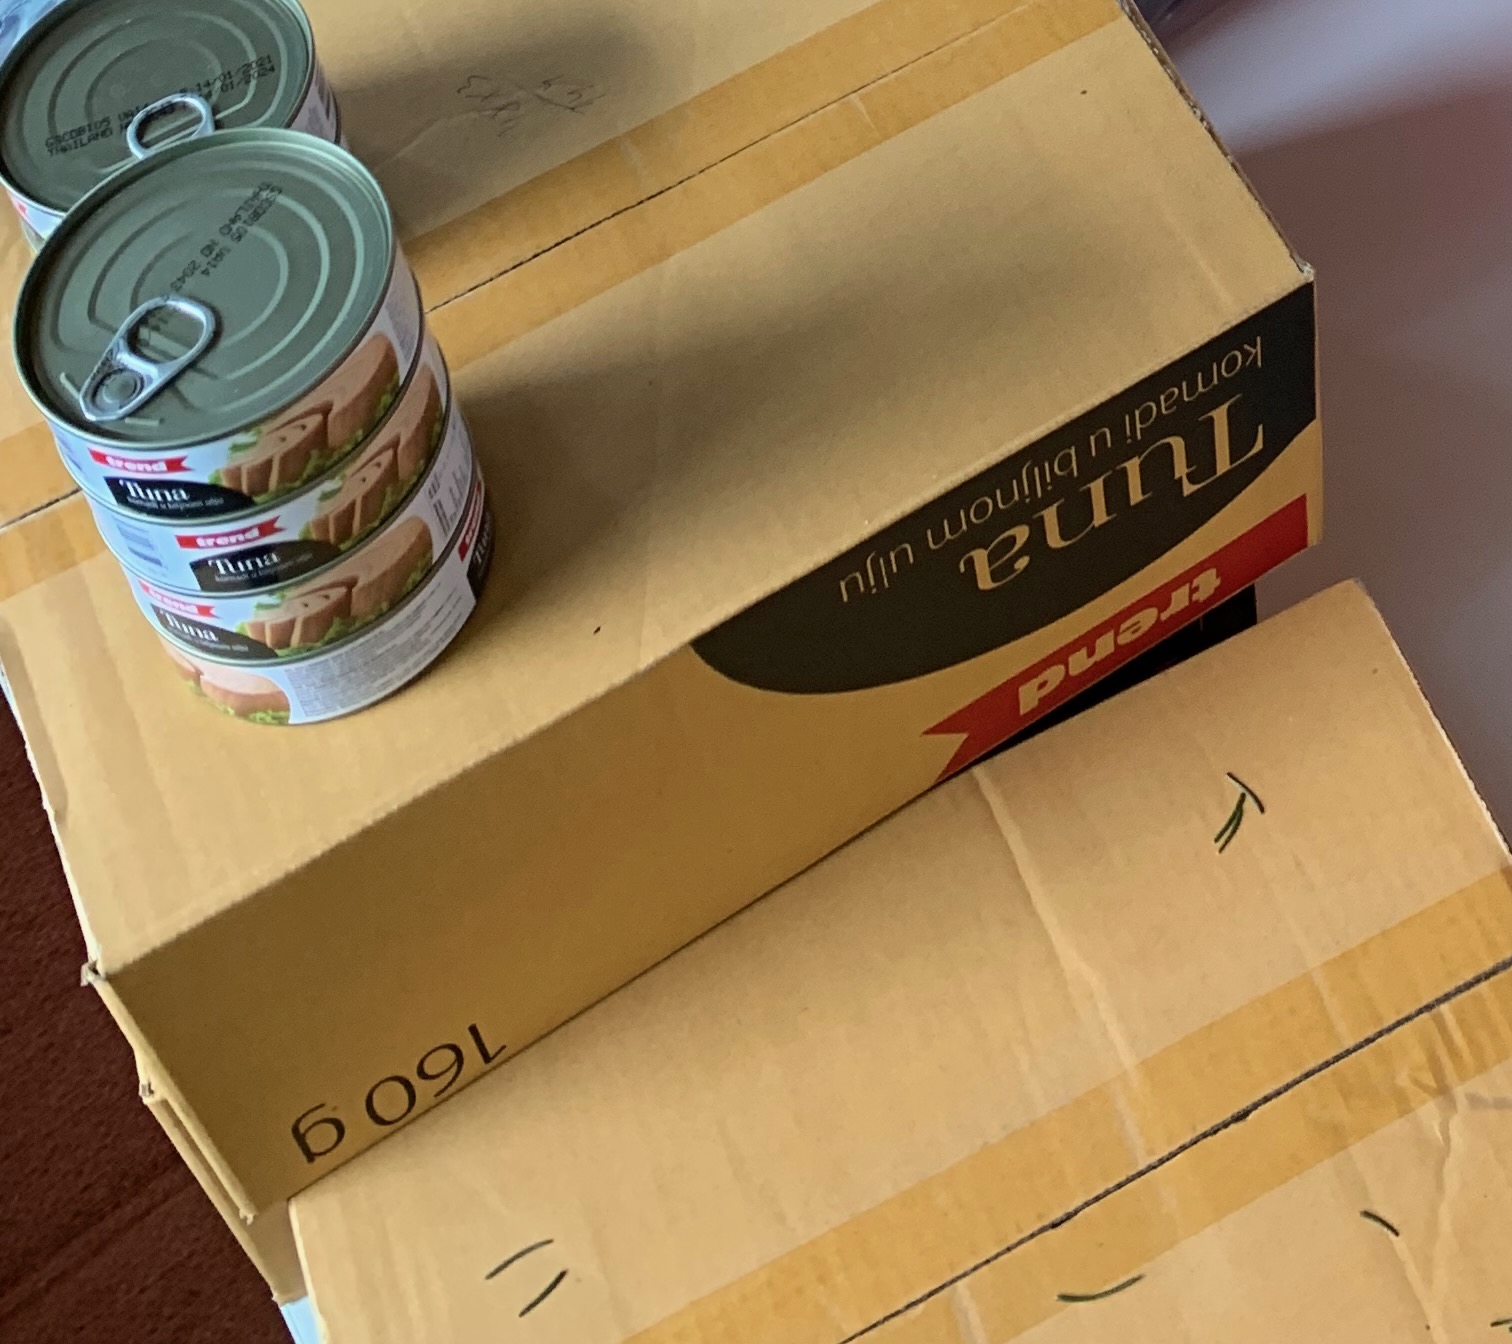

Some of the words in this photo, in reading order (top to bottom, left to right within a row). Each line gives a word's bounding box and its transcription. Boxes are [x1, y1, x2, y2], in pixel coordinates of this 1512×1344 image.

[1125, 335, 1264, 444] komadi
[106, 455, 167, 472] trend
[1091, 426, 1114, 445] u
[119, 479, 190, 502] Tuna
[928, 443, 1078, 550] biljnom
[959, 395, 1264, 590] Tuna
[196, 529, 258, 547] trend
[208, 552, 281, 576] Tuna
[839, 542, 914, 603] ulju
[160, 609, 219, 642] Tuna
[1018, 567, 1221, 715] trend
[365, 1023, 507, 1127] 160
[290, 1104, 345, 1164] g
